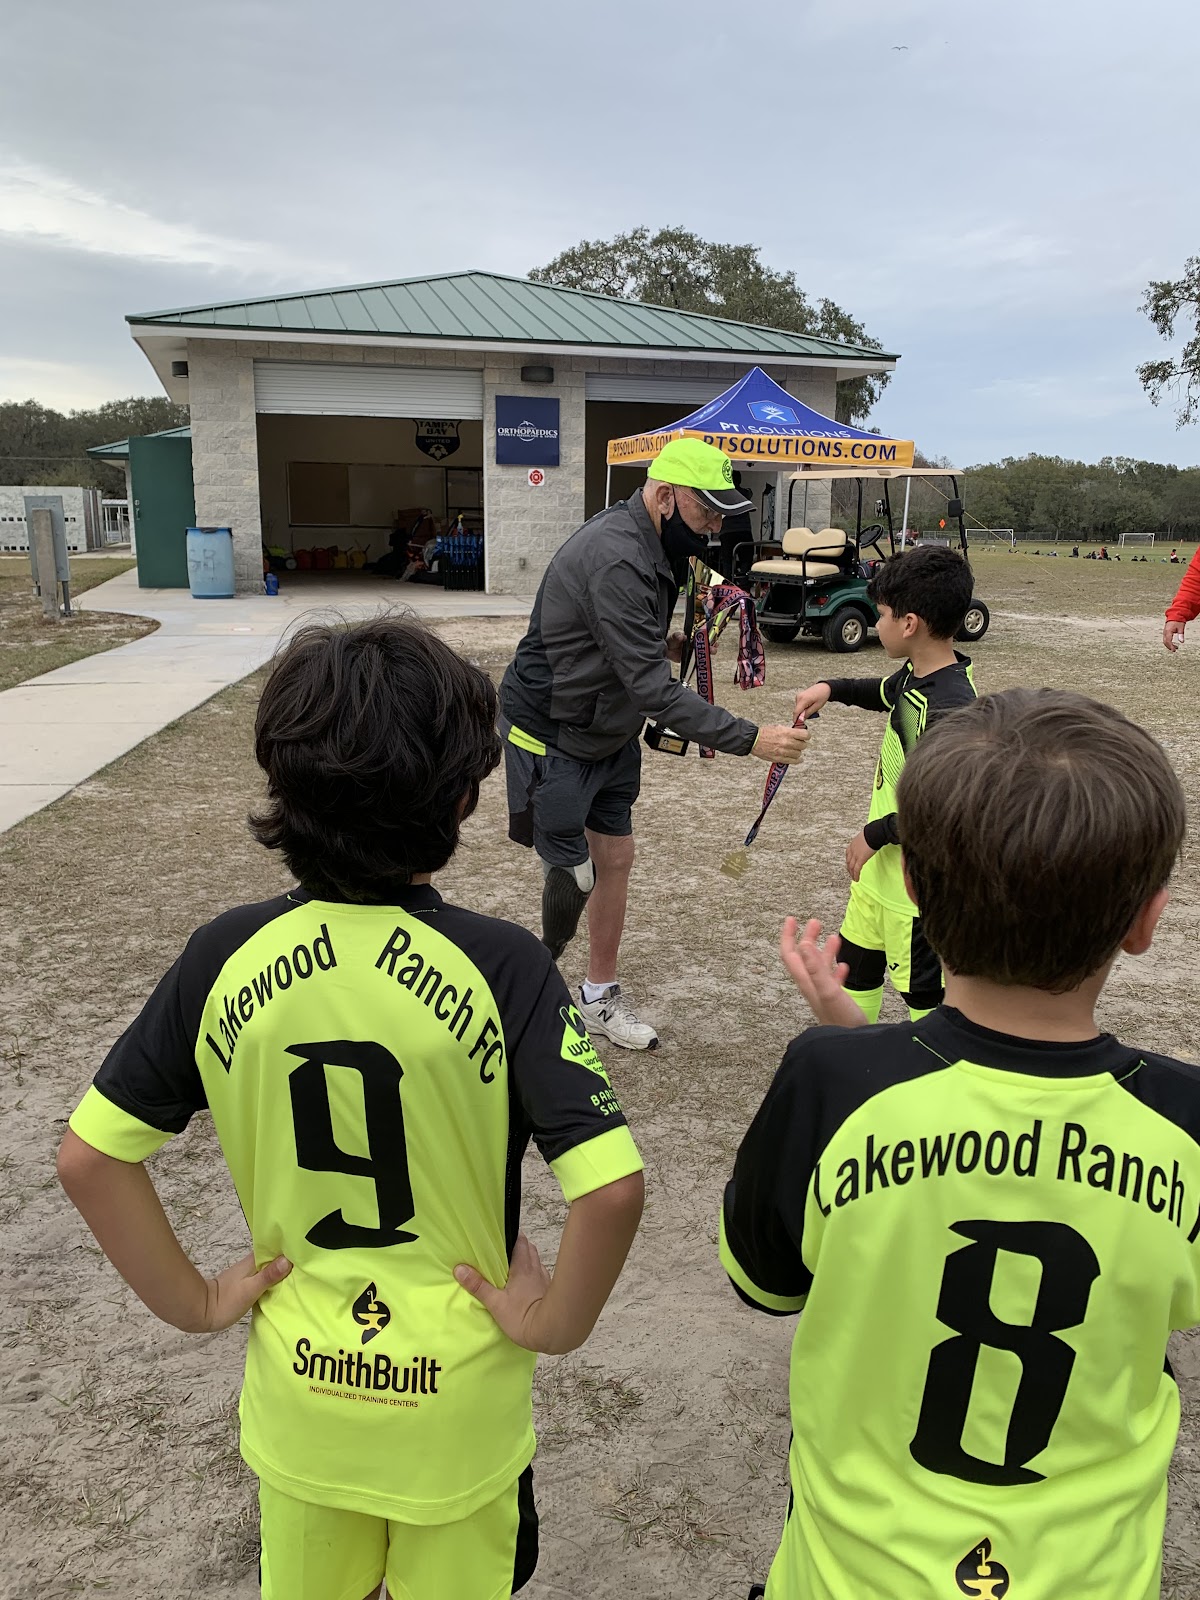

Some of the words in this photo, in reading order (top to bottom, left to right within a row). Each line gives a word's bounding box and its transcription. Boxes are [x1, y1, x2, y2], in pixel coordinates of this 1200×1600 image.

[497, 427, 558, 436] ORTHOPAEDICS
[703, 434, 896, 461] PTSOLUTIONS.COM
[719, 421, 739, 432] PT
[747, 425, 851, 438] SOLUTIONS
[205, 923, 337, 1074] Lakewood
[375, 926, 474, 1038] Ranch
[468, 1017, 503, 1085] FC
[283, 1039, 420, 1250] 9
[812, 1119, 1043, 1218] Lakewood
[1056, 1122, 1186, 1228] Ranch
[292, 1337, 442, 1395] SmithBuilt
[909, 1219, 1102, 1487] 8
[308, 1385, 358, 1400] INDIVIDUALIZED
[358, 1394, 388, 1405] TRAINING
[389, 1399, 419, 1408] CENTERS
